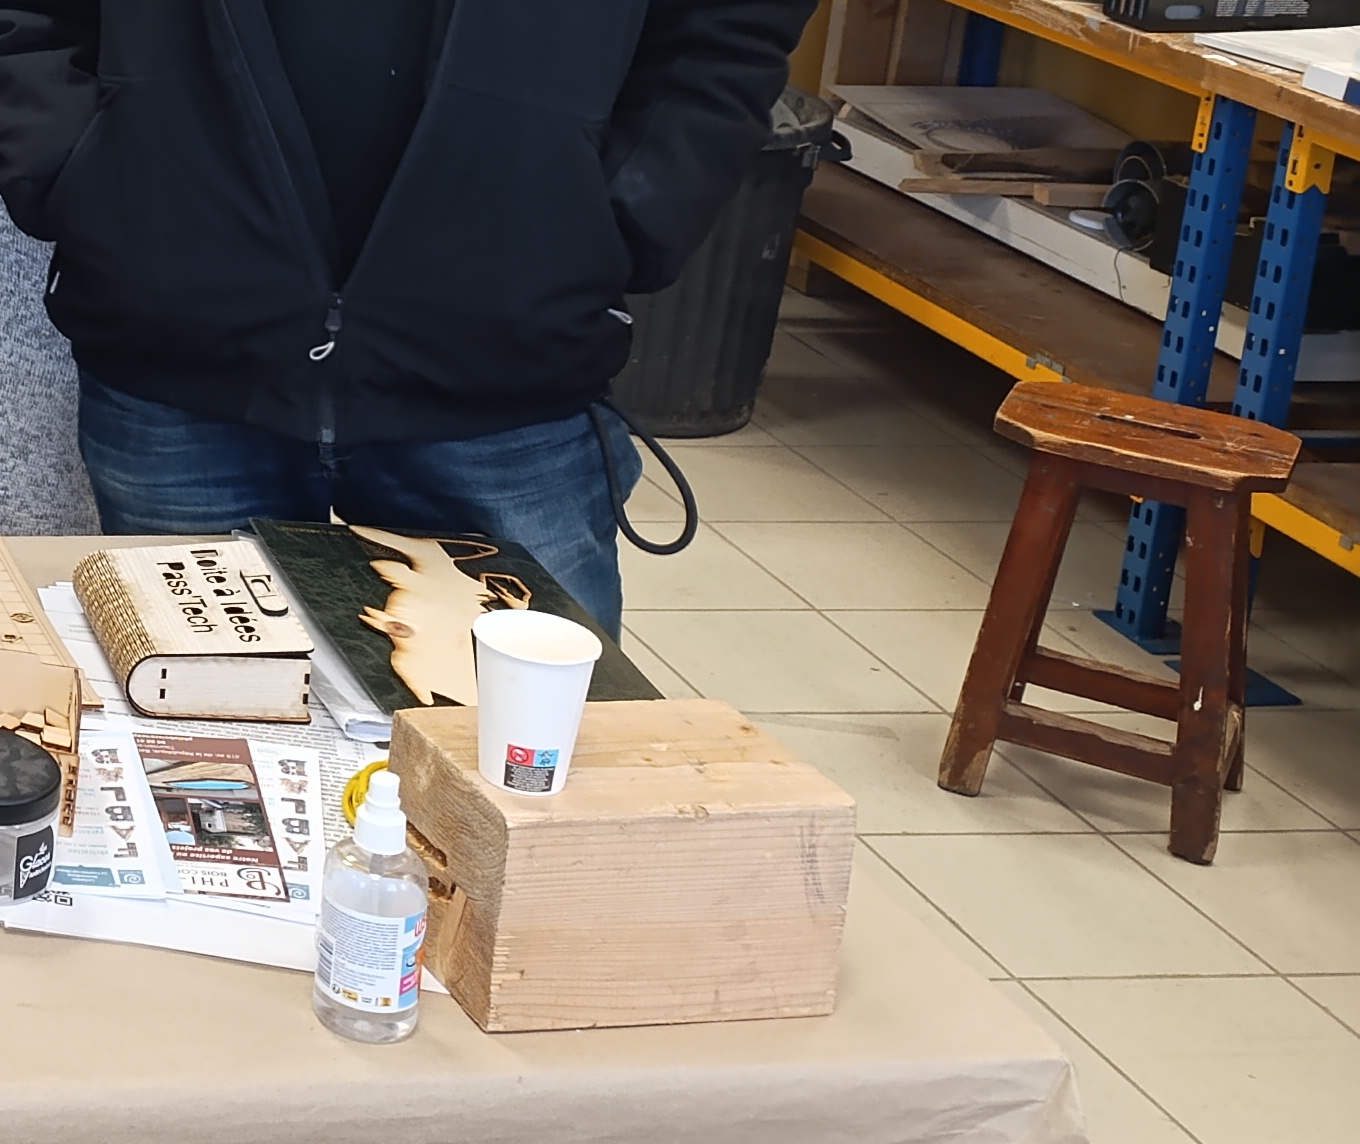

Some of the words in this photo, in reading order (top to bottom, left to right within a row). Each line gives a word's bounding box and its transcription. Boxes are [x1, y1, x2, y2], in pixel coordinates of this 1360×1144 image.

[156, 561, 219, 633] Pass'Tech
[220, 601, 262, 643] Idées
[171, 844, 204, 853] projets
[204, 846, 221, 854] vos
[221, 848, 234, 856] de
[189, 851, 232, 861] expertise
[233, 855, 260, 864] Notre
[200, 869, 228, 877] BOIS
